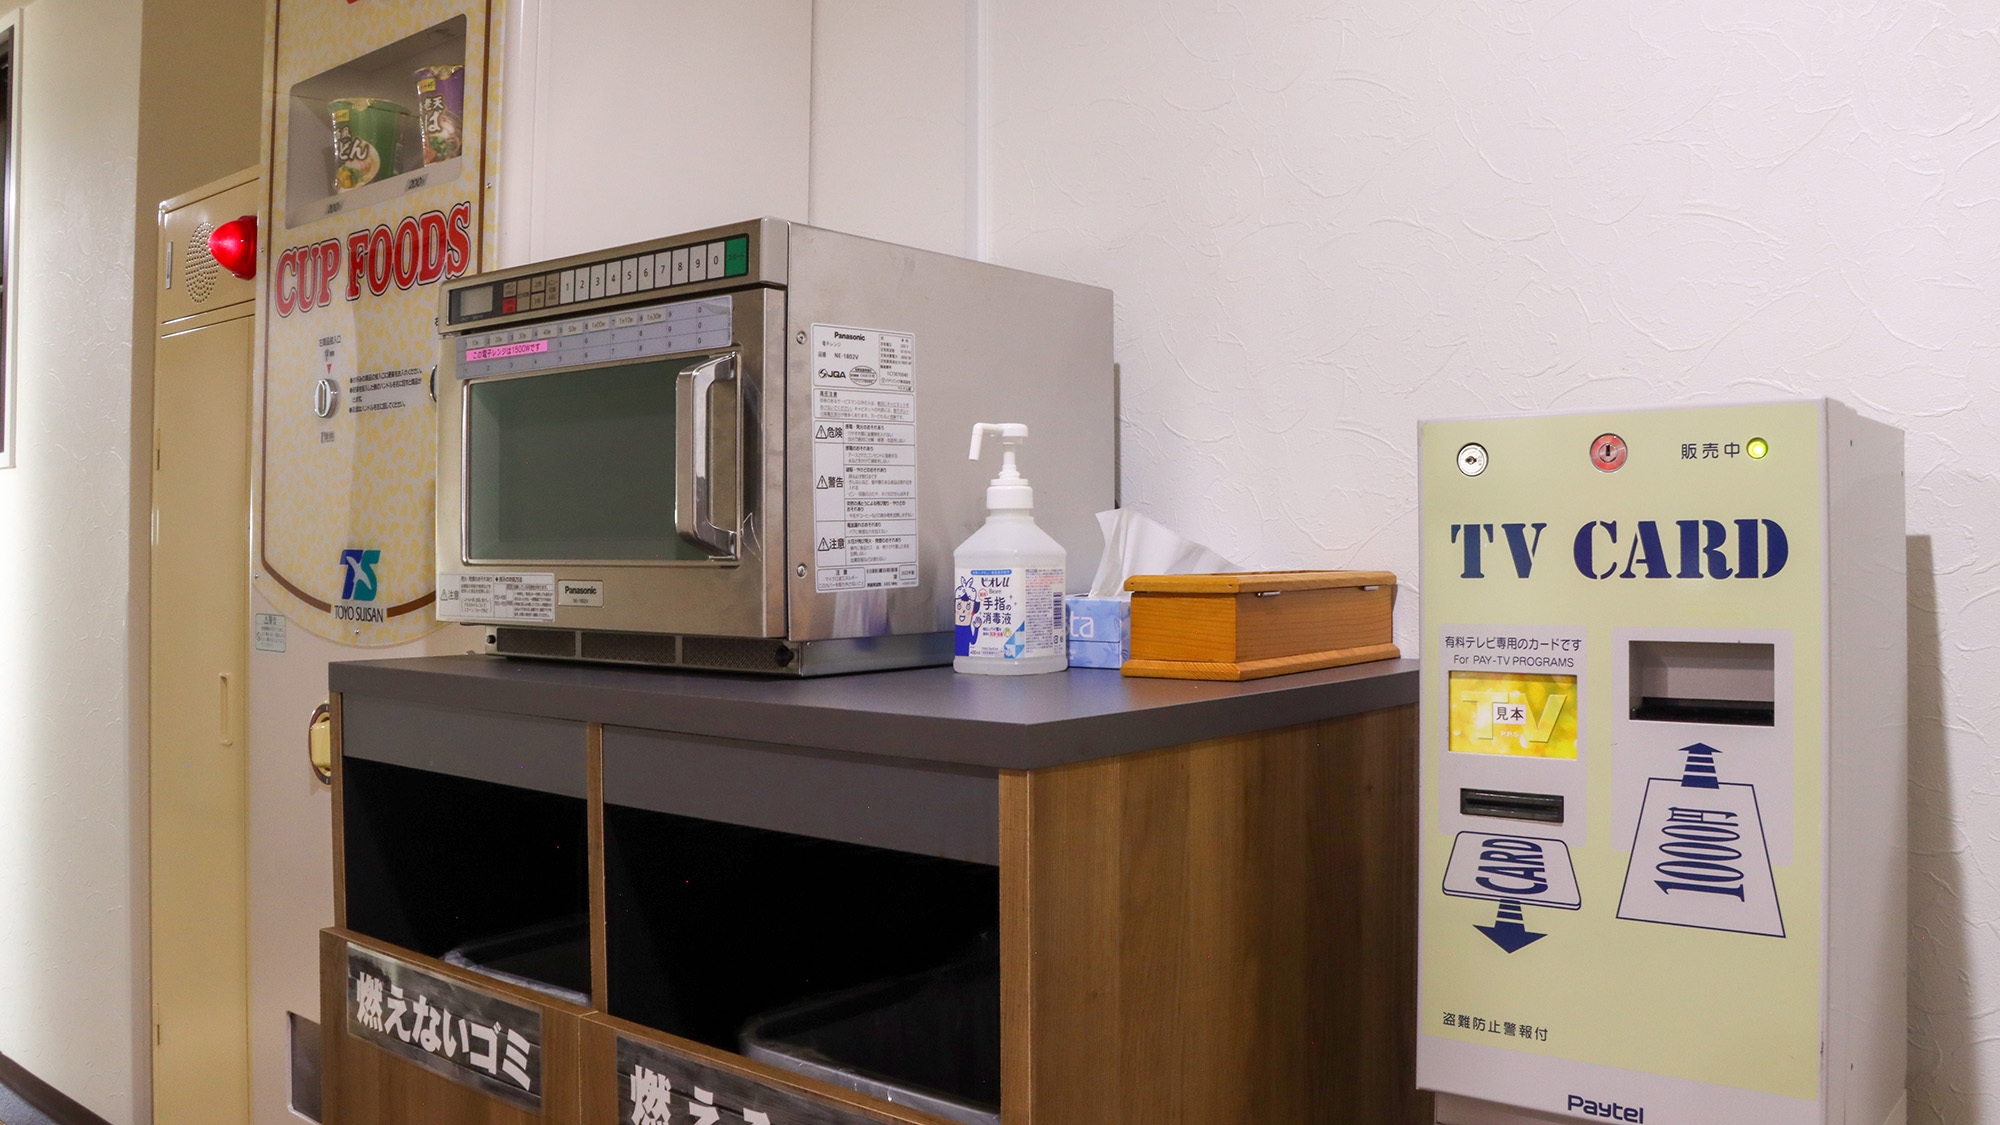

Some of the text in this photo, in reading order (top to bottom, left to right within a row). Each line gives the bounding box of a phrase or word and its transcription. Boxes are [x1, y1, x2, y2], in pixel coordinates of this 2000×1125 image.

[276, 201, 471, 318] CUP FOODS
[834, 331, 865, 341] Panasonic
[827, 426, 843, 438] 危険
[1681, 442, 1740, 460] 販売中
[828, 476, 843, 488] 警告
[829, 538, 845, 549] 注意
[1450, 519, 1789, 580] TV CARD
[565, 585, 597, 595] Panasonic
[983, 597, 1012, 610] 手指の
[334, 605, 383, 623] TOYO SUISAN
[982, 612, 1012, 625] 消毒液
[1445, 636, 1582, 651] 有料テレビ専用のカードです
[1454, 655, 1574, 668] For PAY-TV PROGRAMS
[1496, 707, 1524, 721] 見本
[1654, 806, 1745, 902] 1000円
[1475, 838, 1549, 895] CARD
[356, 972, 531, 1091] 燃えないゴミ
[1442, 1011, 1549, 1042] 盗難防止警報付
[630, 1064, 771, 1125] 燃え
[1567, 1094, 1644, 1124] Paytel
